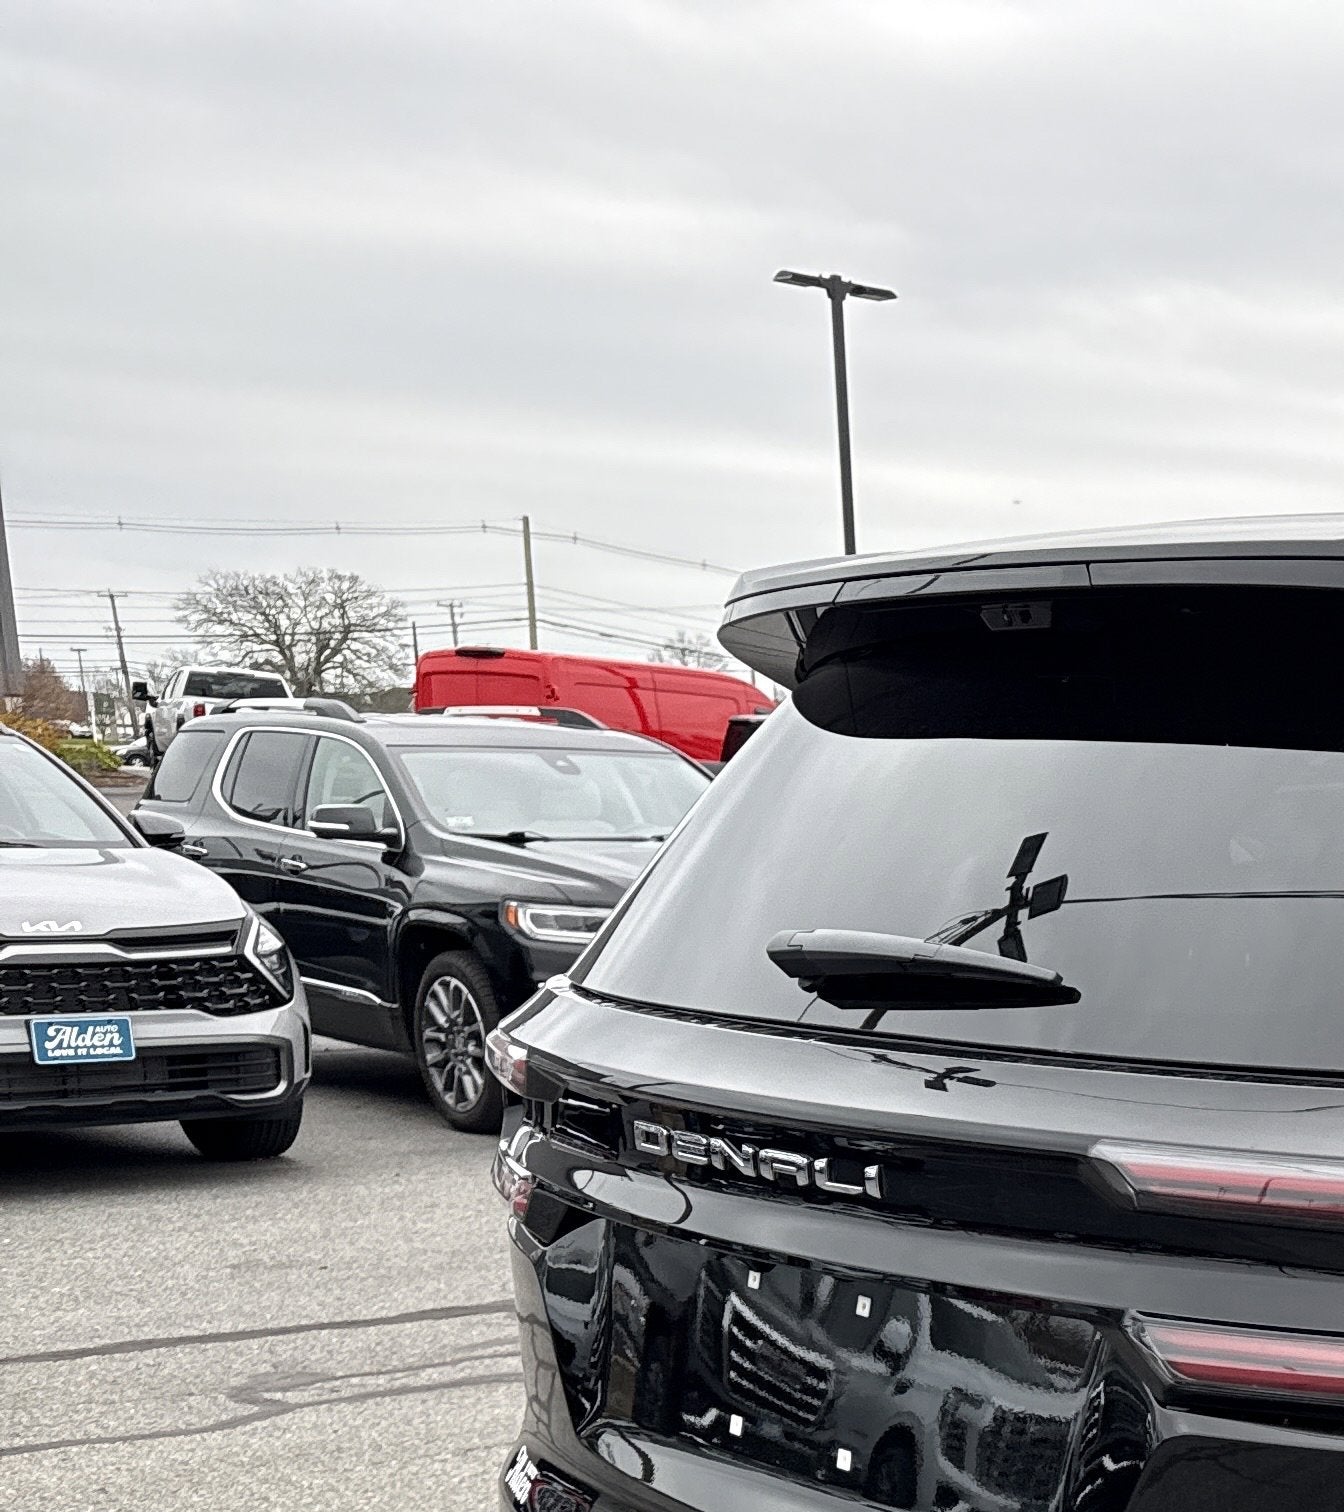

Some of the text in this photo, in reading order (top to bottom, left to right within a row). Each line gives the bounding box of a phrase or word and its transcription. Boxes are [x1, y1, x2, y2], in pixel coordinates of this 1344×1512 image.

[44, 1024, 123, 1049] Alden
[94, 1024, 118, 1033] AUTO
[47, 1046, 123, 1057] LOVE IT LOCAL
[633, 1120, 884, 1200] DENALI
